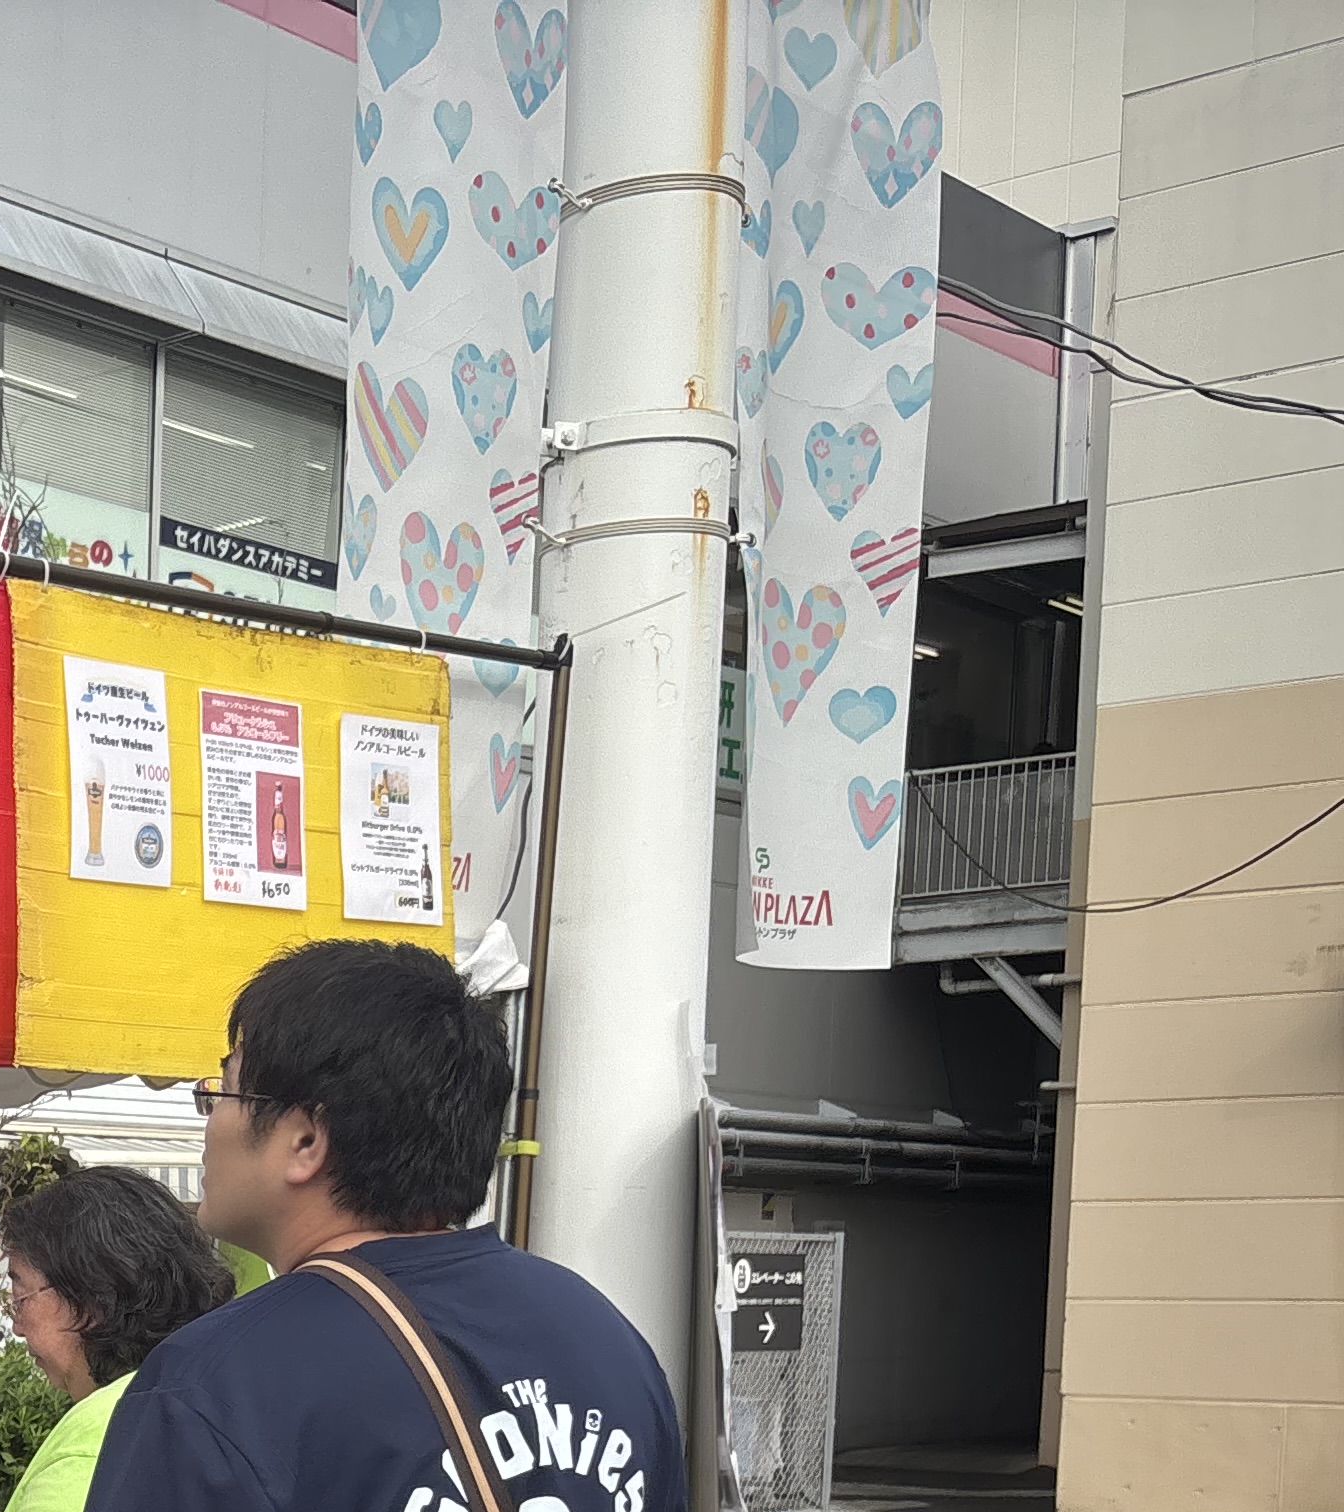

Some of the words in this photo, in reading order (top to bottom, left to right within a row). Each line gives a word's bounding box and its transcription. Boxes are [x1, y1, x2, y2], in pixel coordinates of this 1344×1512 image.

[174, 525, 323, 580] セイハダンスアカデミー
